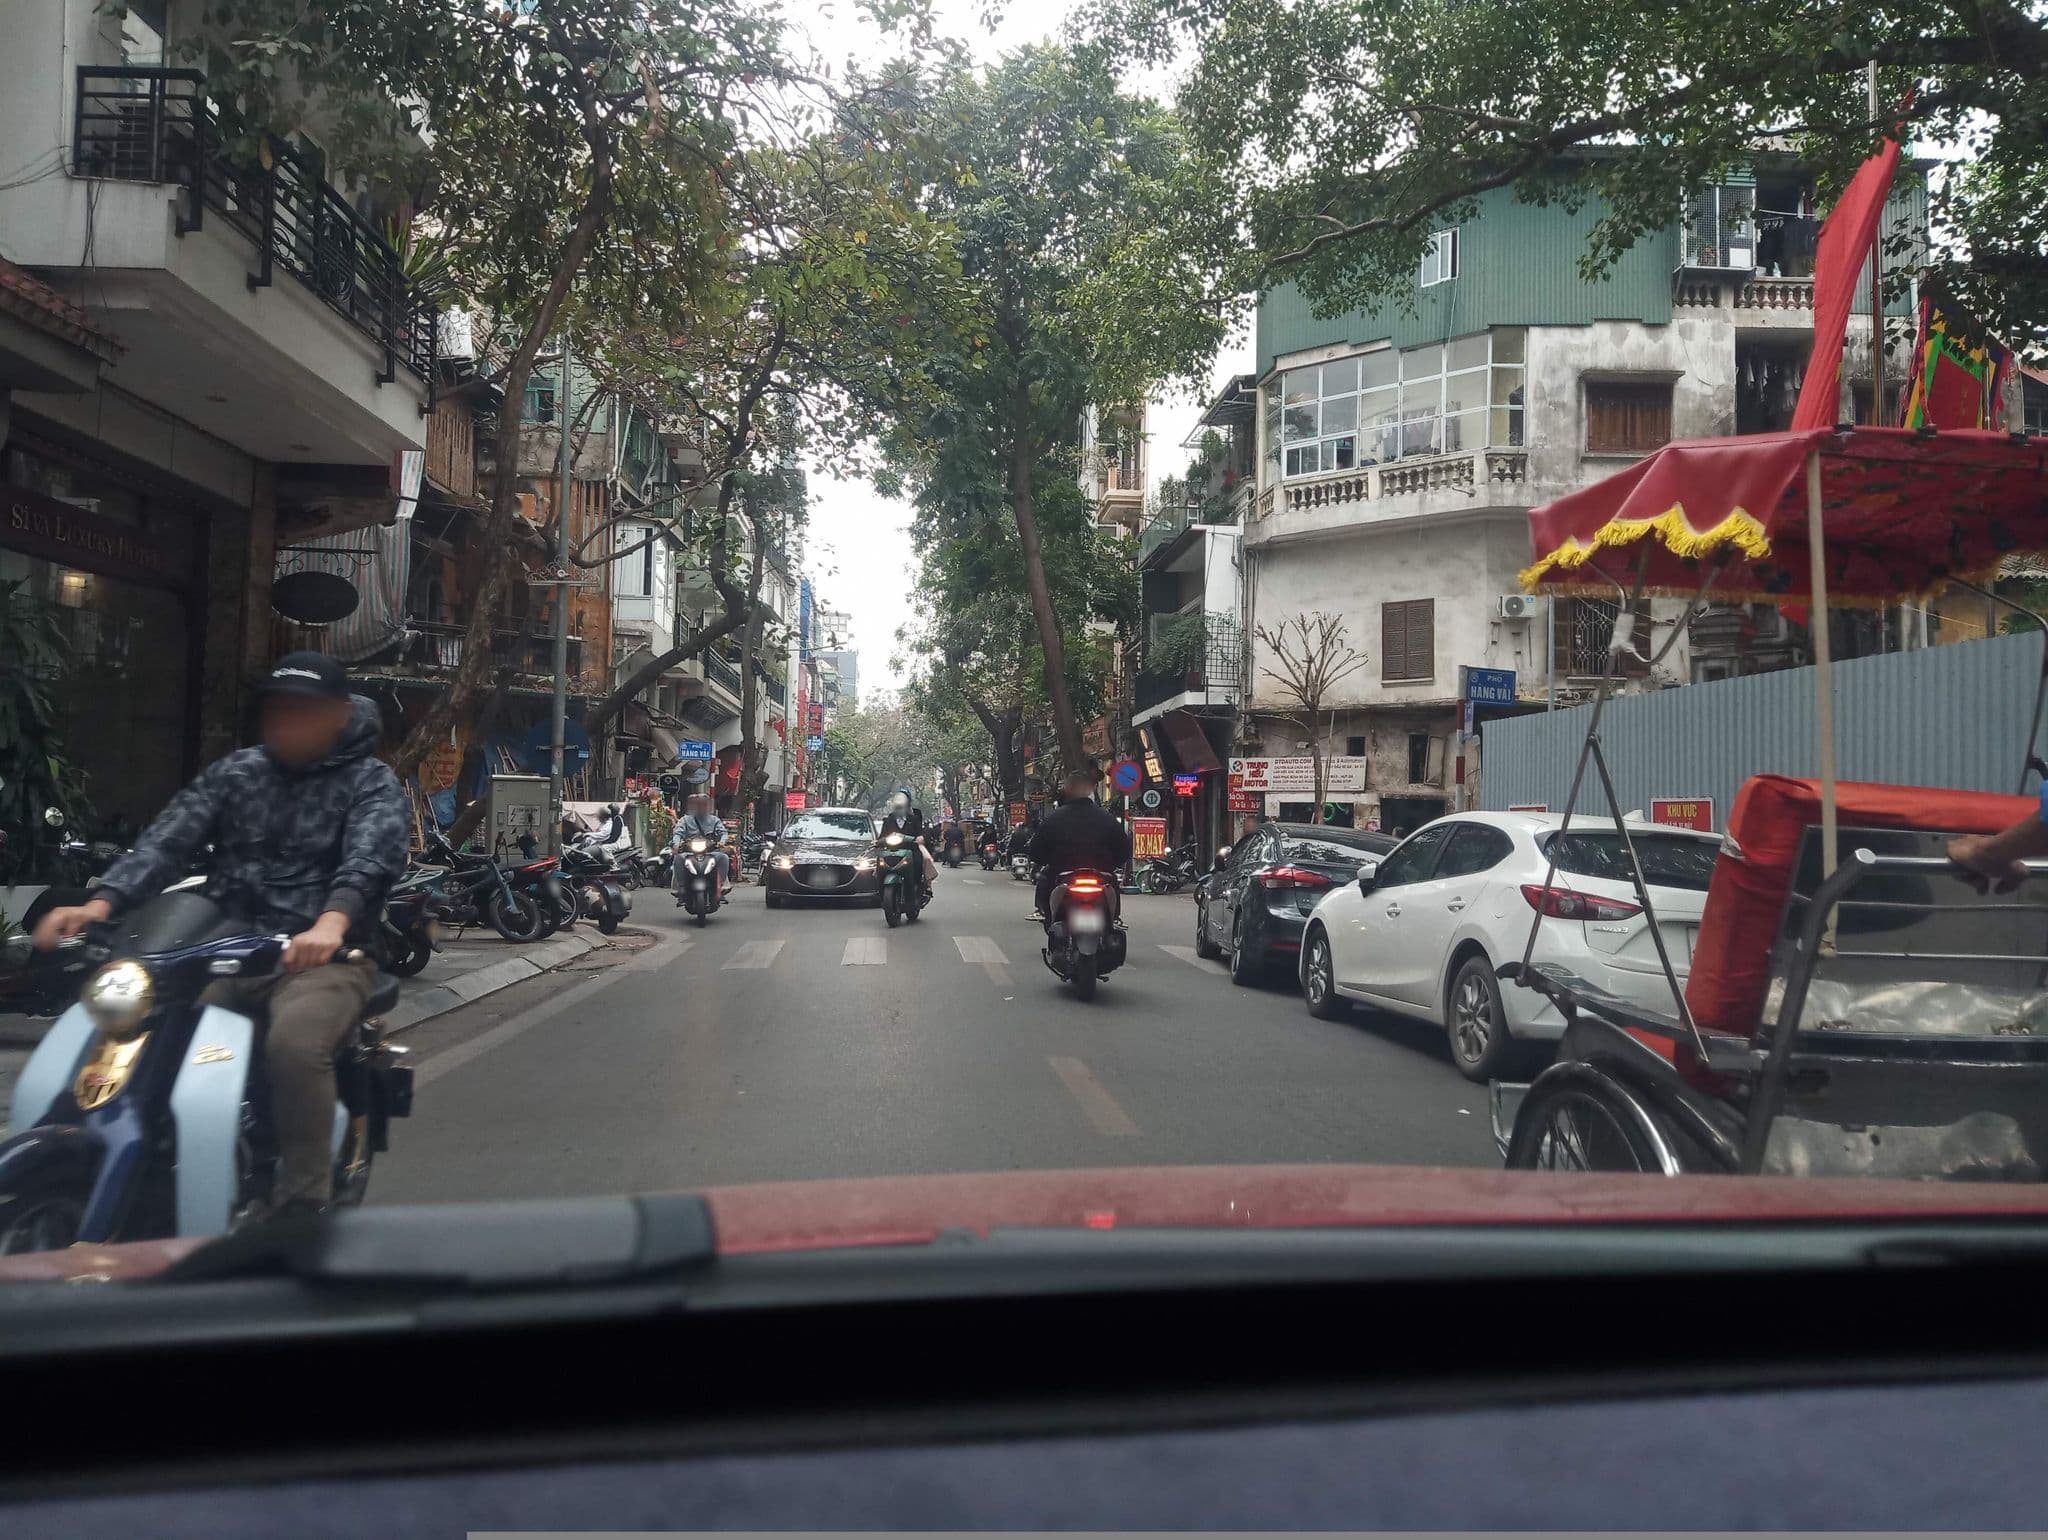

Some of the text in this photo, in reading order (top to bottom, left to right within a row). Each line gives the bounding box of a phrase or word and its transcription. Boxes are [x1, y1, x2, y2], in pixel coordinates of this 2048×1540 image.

[1487, 673, 1504, 683] PHỐ
[1470, 683, 1512, 701] HÀNG VẢI
[681, 749, 699, 758] HÀNG
[1246, 761, 1269, 769] TRUNG
[1666, 803, 1698, 820] KHU VỰC
[1135, 827, 1164, 855] XE MÁY
